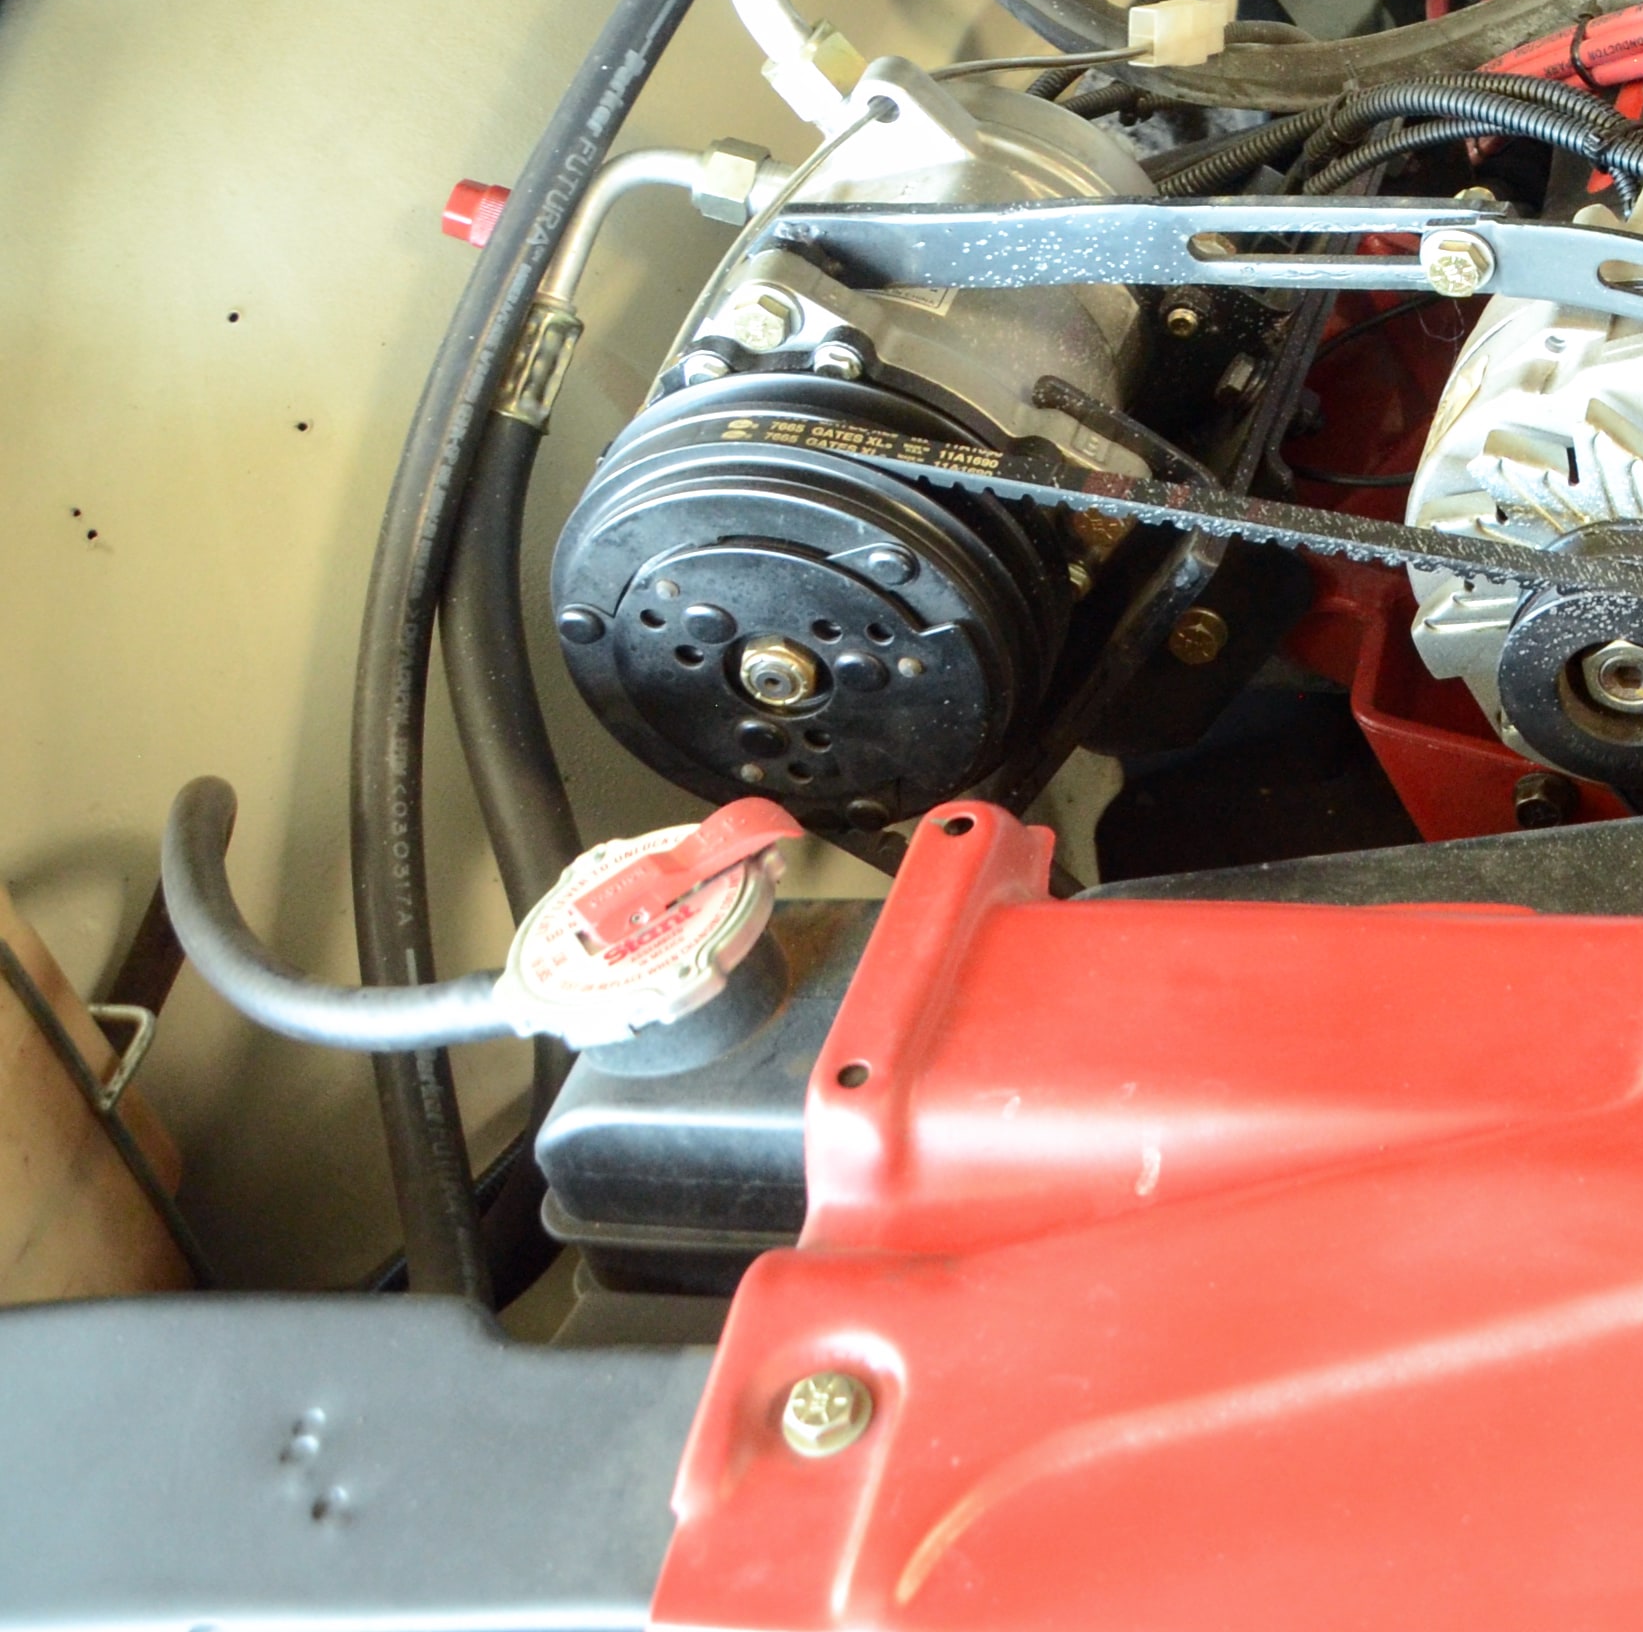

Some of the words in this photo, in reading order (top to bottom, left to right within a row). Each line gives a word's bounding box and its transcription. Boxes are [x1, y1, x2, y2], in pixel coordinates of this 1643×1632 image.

[525, 135, 598, 245] FUTURA
[811, 426, 864, 445] GATES
[938, 449, 1000, 469] 11A1690
[603, 904, 697, 967] Stant
